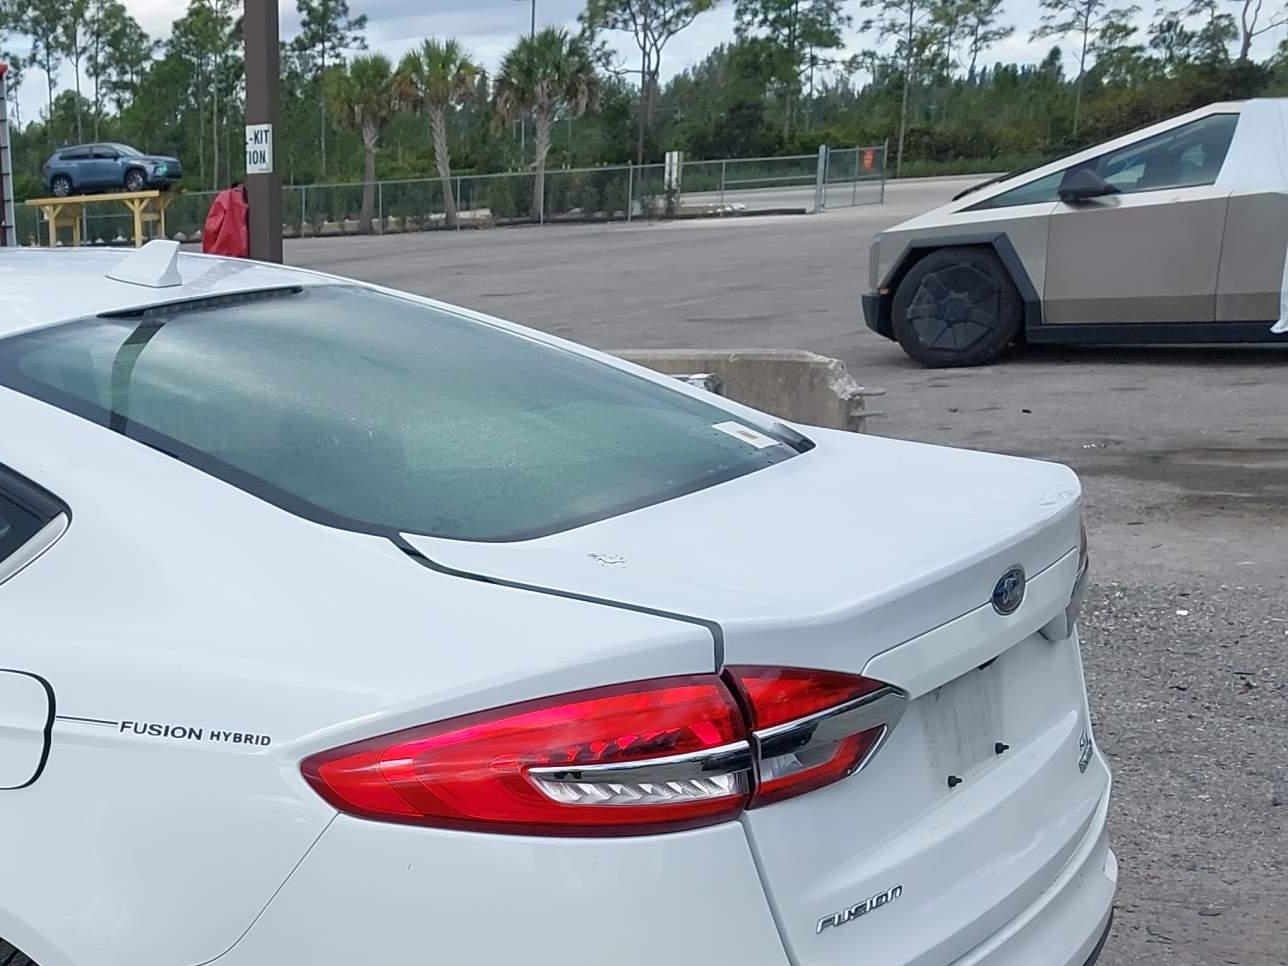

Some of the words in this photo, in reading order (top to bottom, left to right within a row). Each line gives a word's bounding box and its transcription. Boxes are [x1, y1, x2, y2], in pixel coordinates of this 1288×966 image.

[245, 129, 270, 149] -KIT
[247, 150, 266, 166] ION
[119, 720, 204, 740] FUSION
[209, 729, 272, 746] HYBRID
